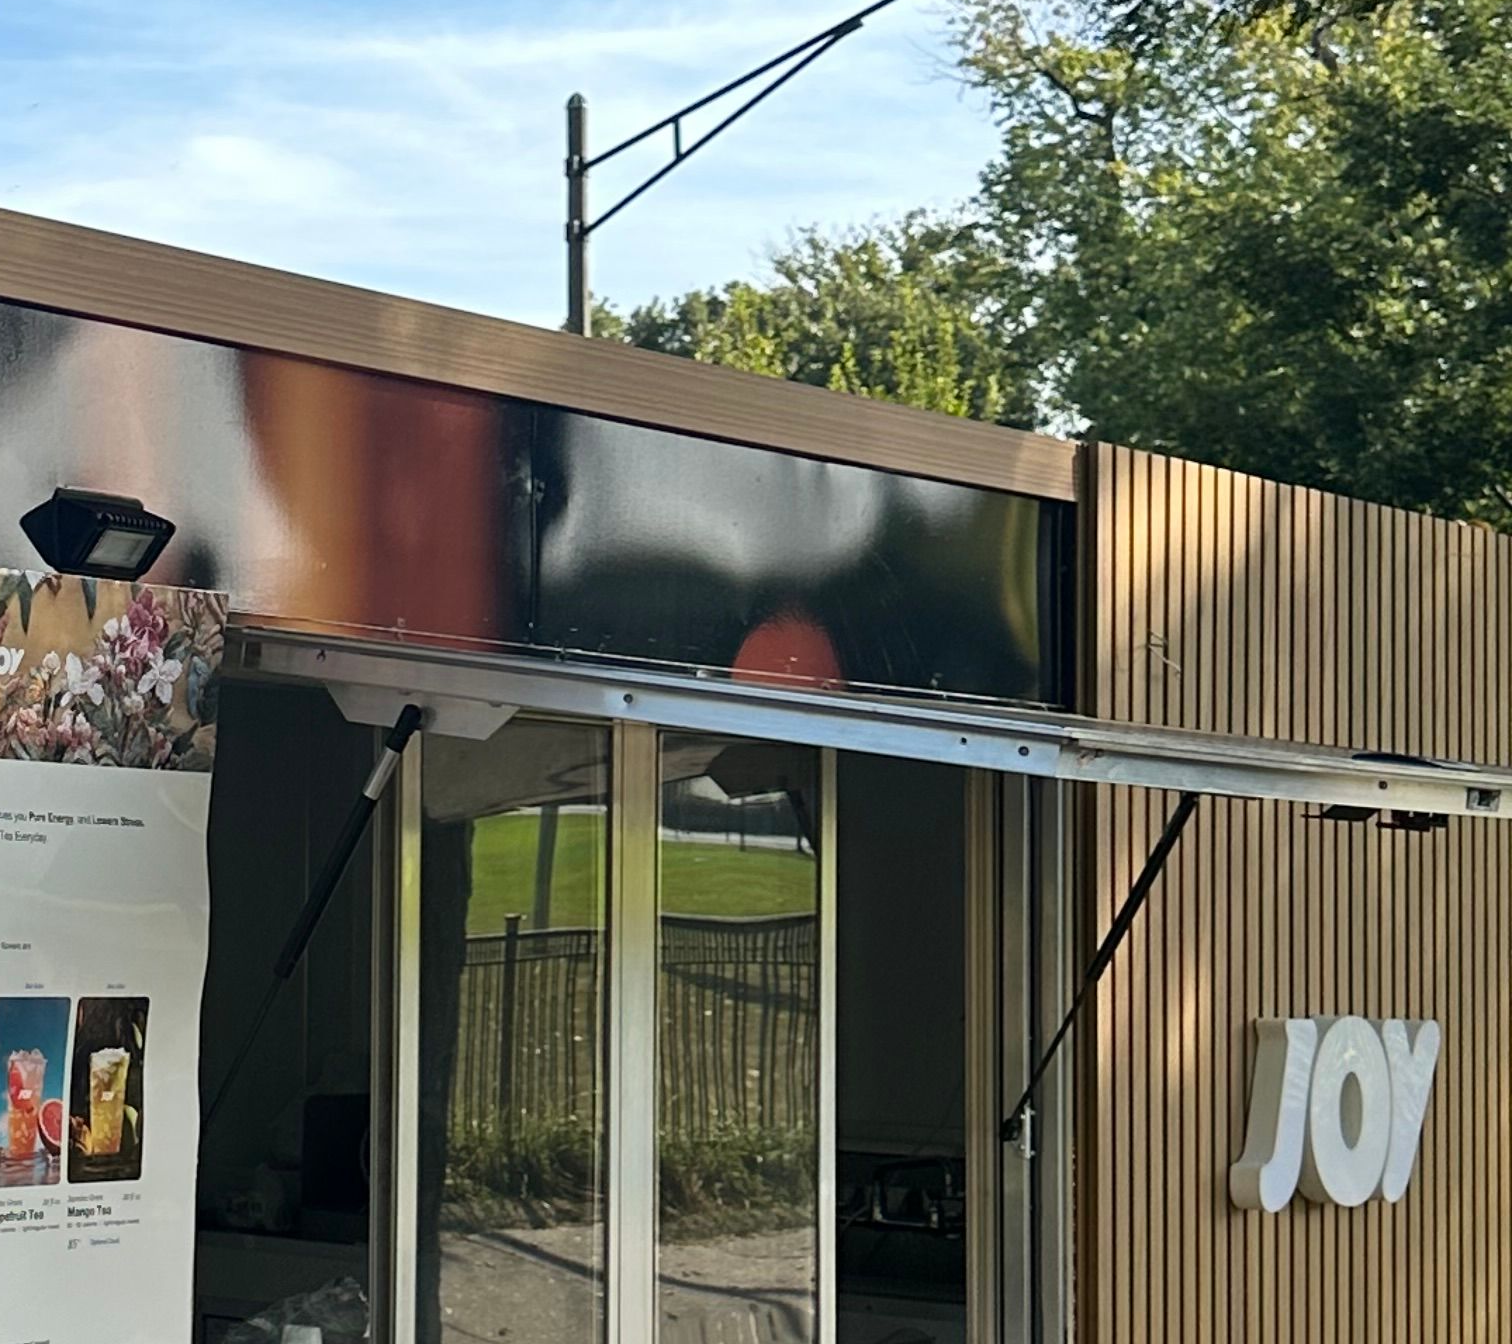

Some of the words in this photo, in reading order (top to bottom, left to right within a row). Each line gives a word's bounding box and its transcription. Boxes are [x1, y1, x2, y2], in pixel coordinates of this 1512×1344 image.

[1229, 1015, 1441, 1213] JOY
[29, 1208, 44, 1220] Tea
[67, 1205, 95, 1219] Mango
[96, 1205, 112, 1216] Tea
